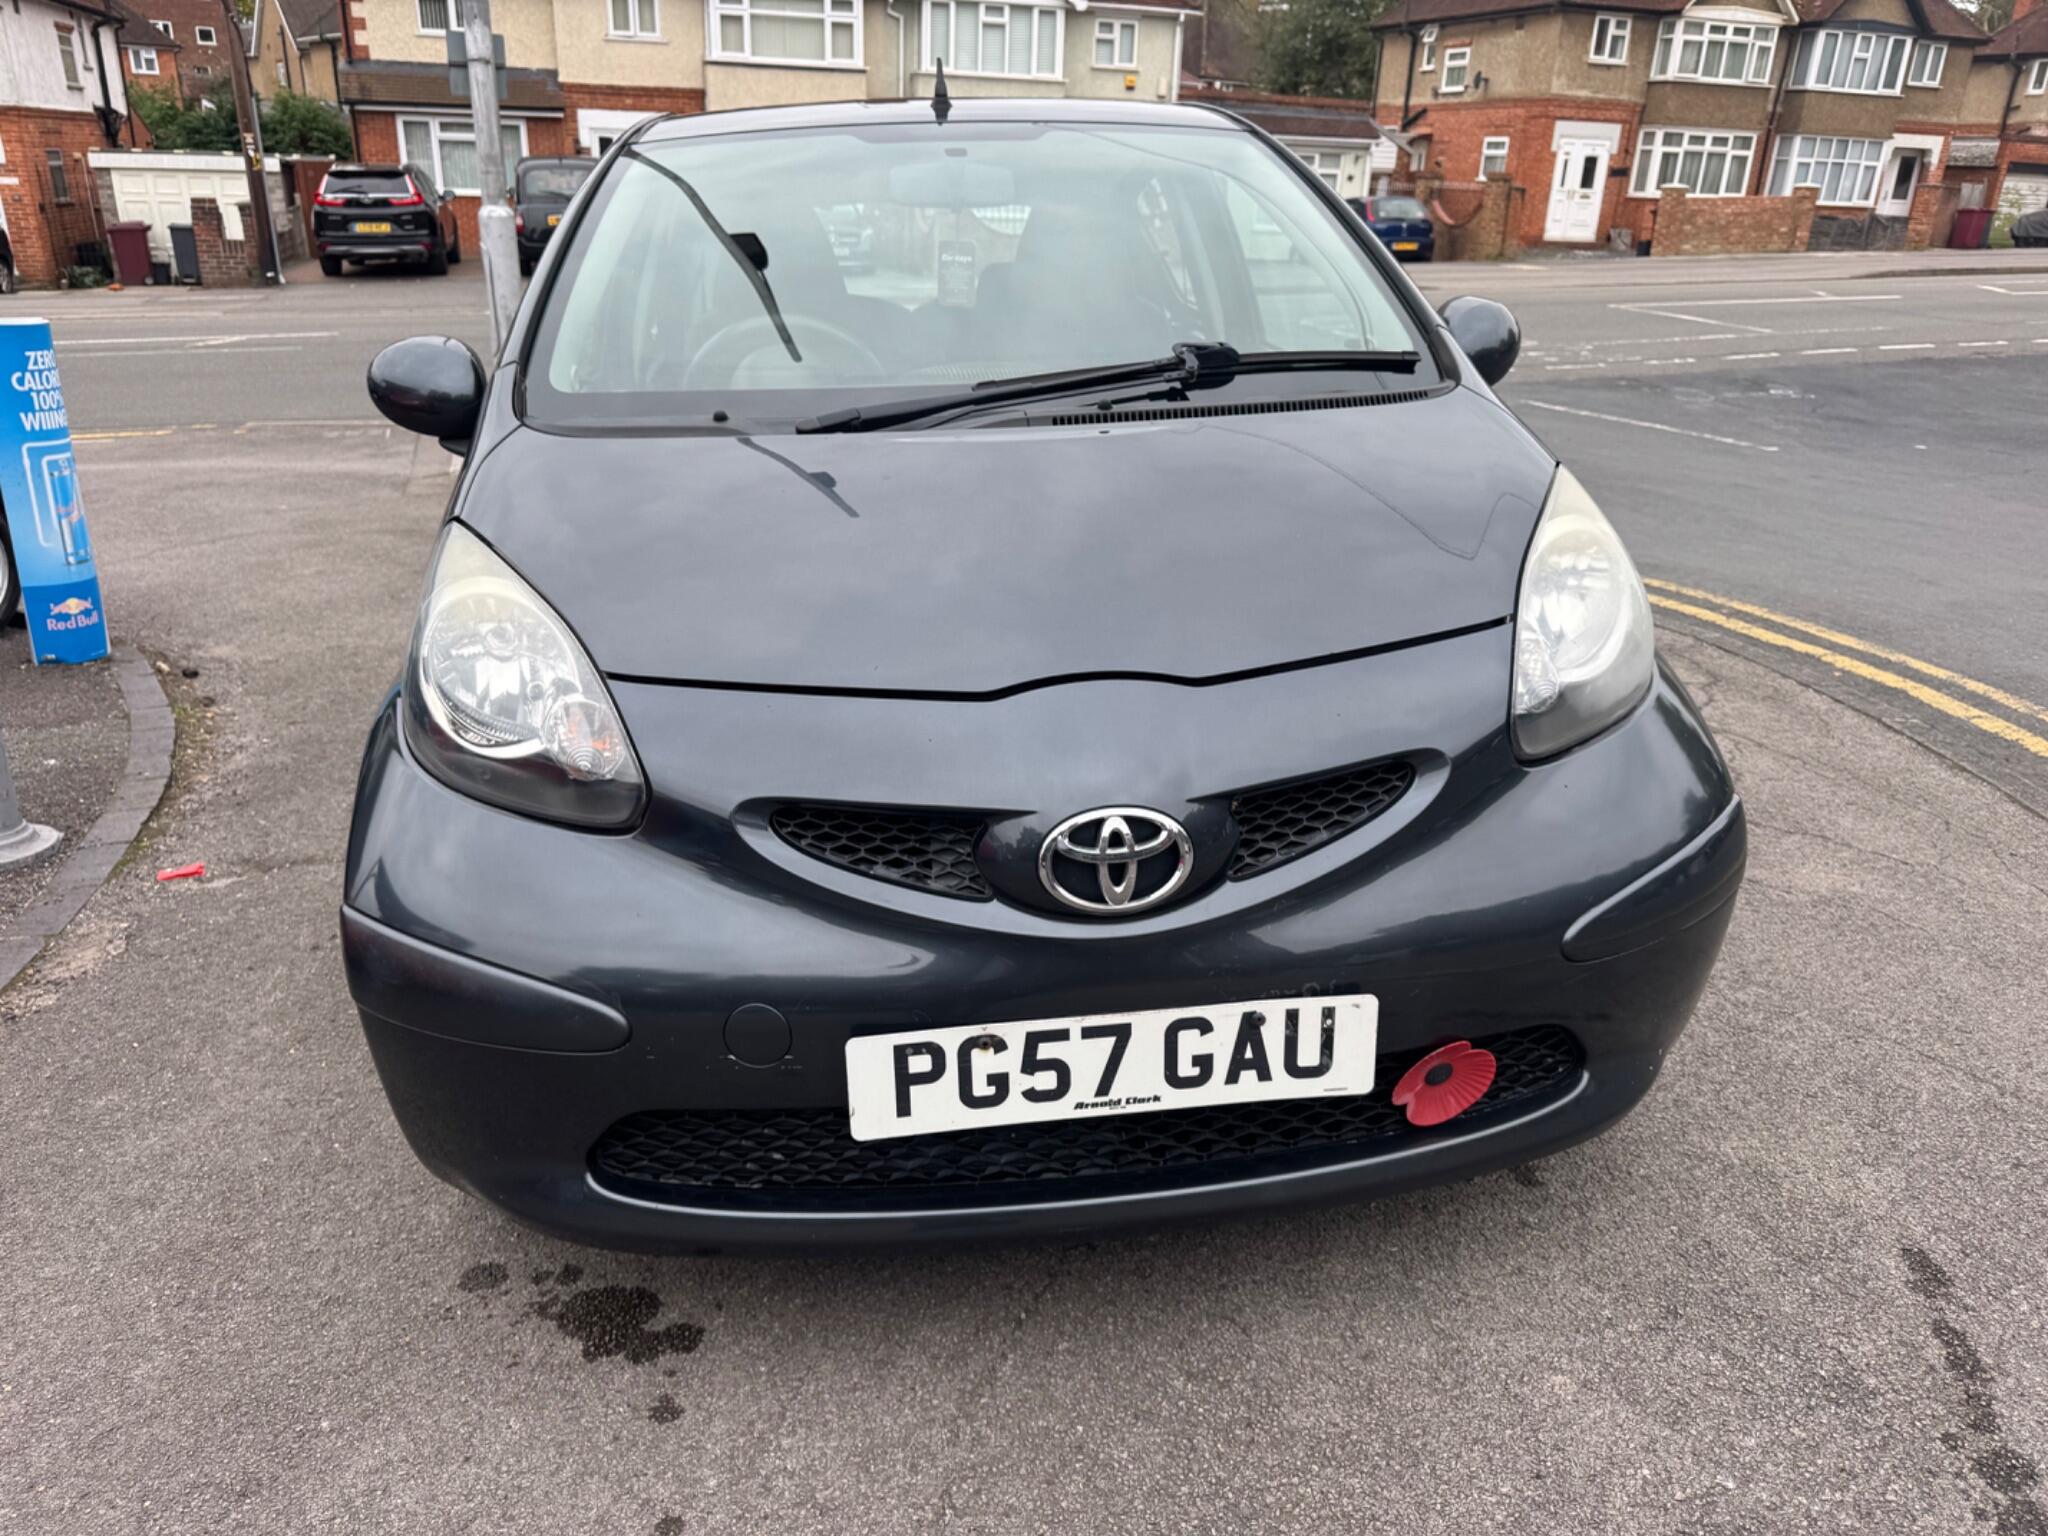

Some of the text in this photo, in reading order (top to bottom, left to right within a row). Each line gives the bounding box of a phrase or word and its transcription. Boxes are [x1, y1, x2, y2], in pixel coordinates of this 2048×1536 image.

[47, 610, 98, 631] Red Bull
[892, 1006, 1335, 1118] PG57 GAU
[1074, 1094, 1161, 1110] Arnold Clark
